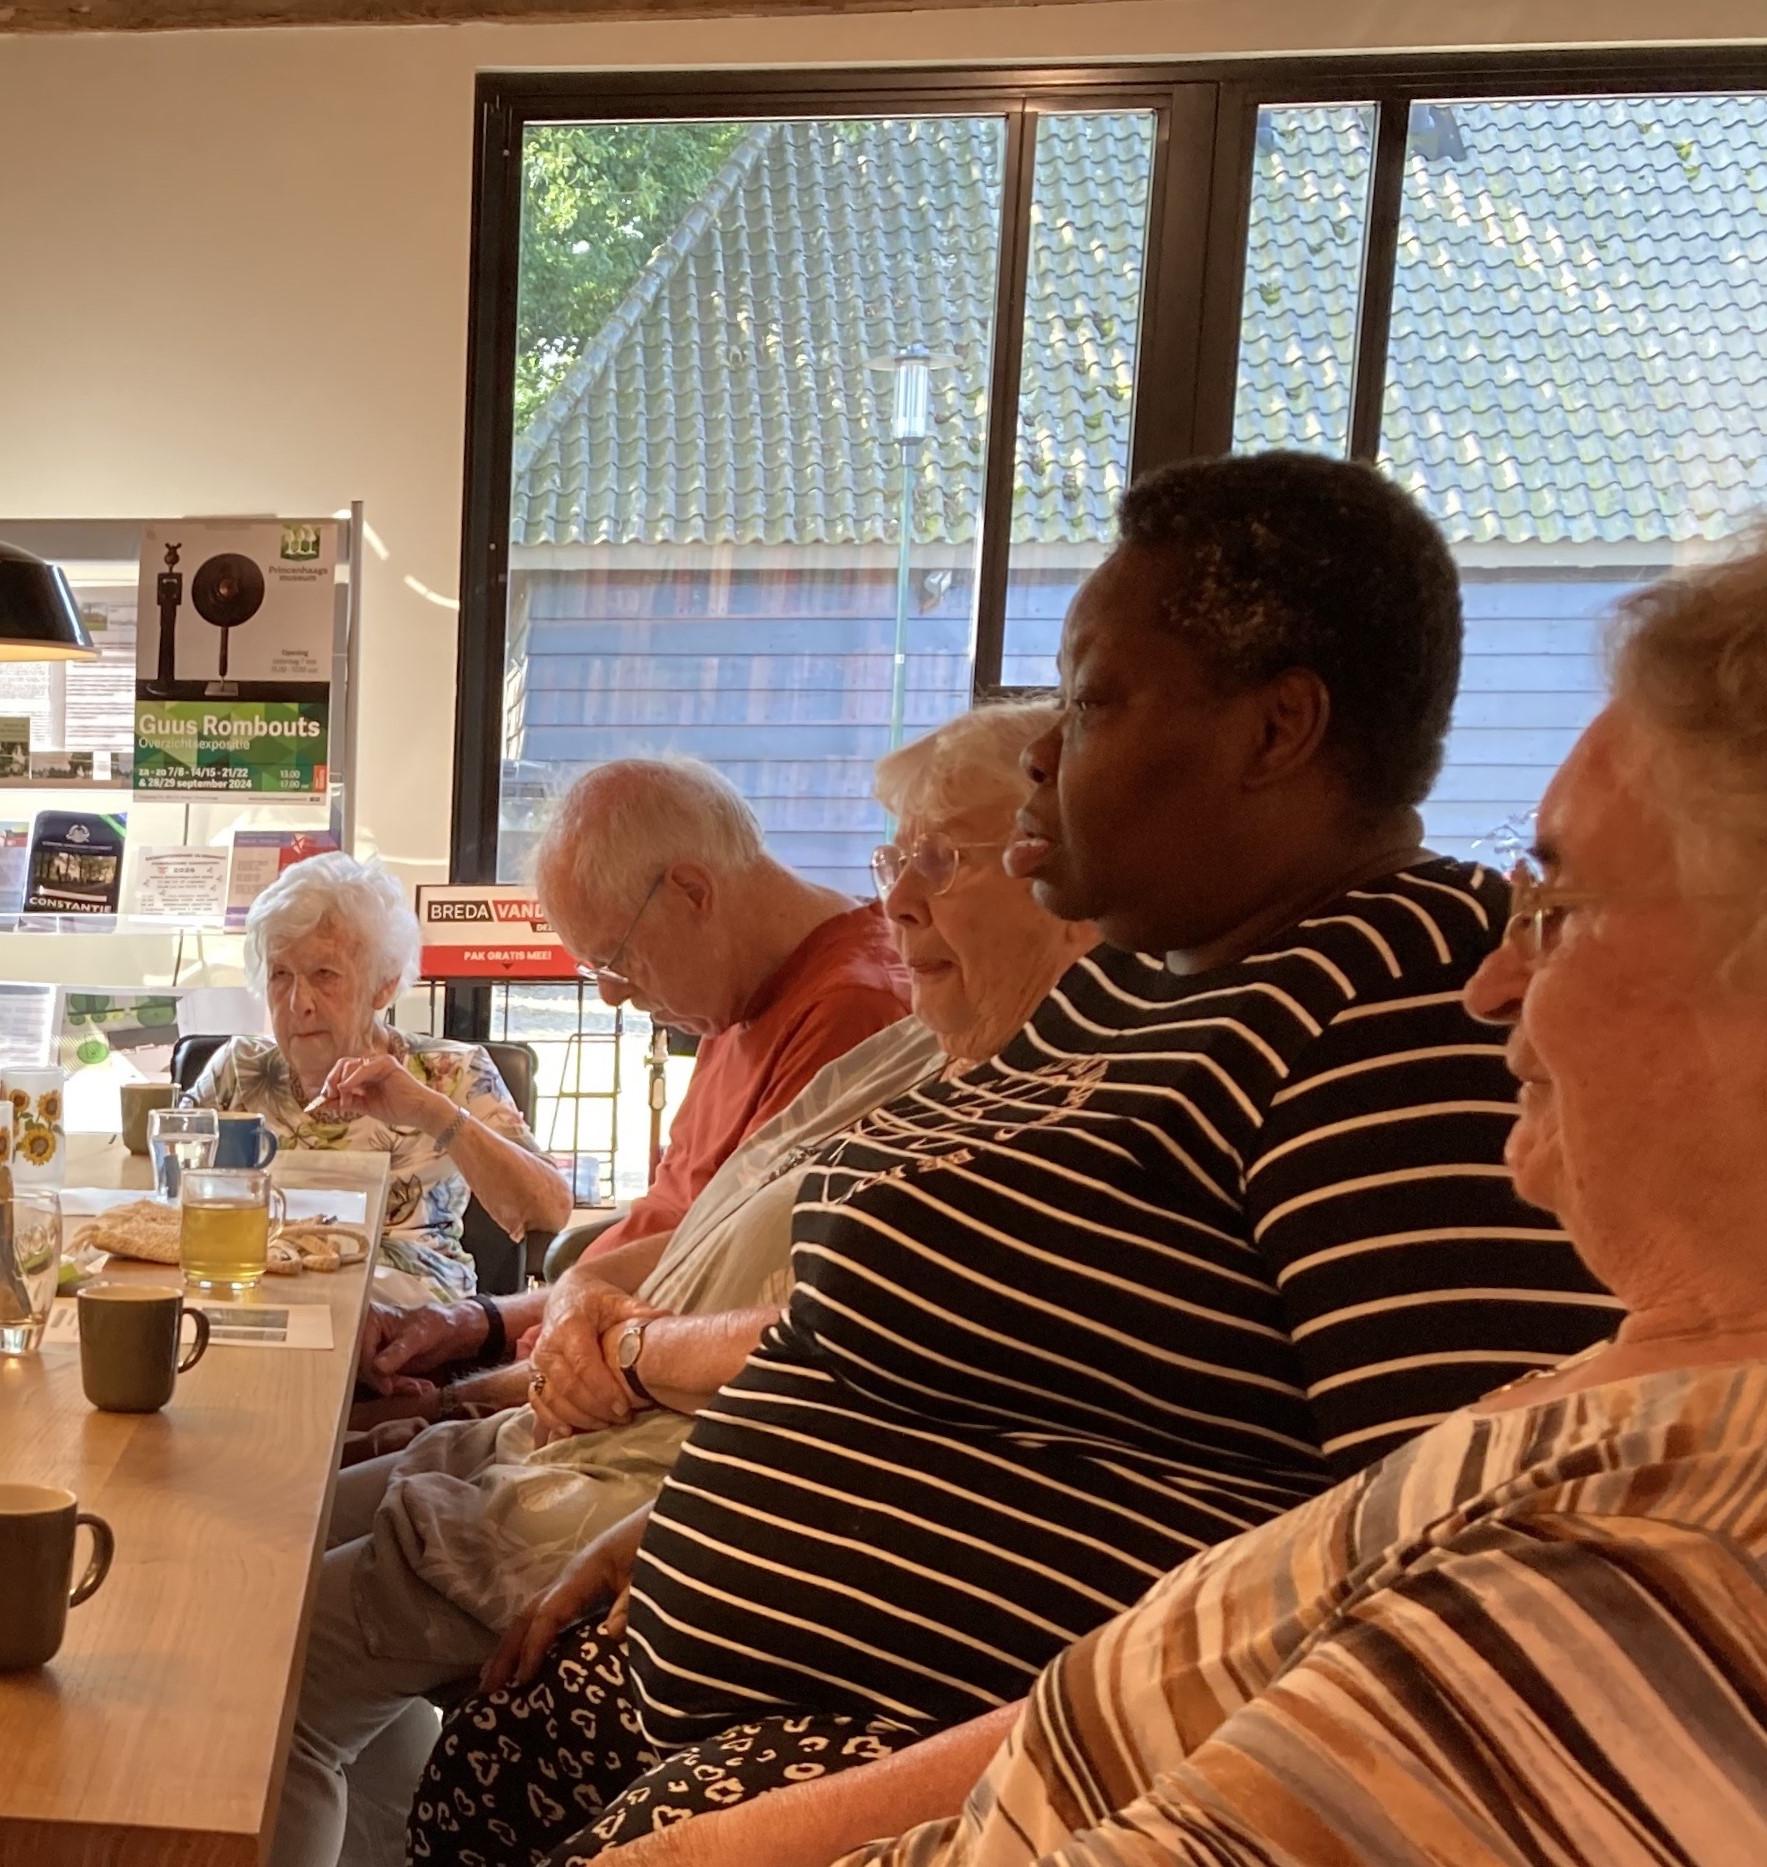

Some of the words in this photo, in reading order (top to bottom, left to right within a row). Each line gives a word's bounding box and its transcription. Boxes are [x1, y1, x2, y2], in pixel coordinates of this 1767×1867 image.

[139, 714, 198, 735] Guus
[203, 714, 321, 737] Rombouts
[138, 737, 251, 752] Overzichtsexpositie
[222, 768, 249, 778] 21/22
[148, 779, 175, 788] 28/29
[176, 779, 228, 790] september
[229, 779, 253, 788] 2024
[28, 896, 112, 913] CONSTANTIE
[431, 904, 490, 919] BREDA
[463, 951, 486, 960] PAK
[487, 951, 526, 960] GRATIS
[526, 951, 552, 960] MEE!
